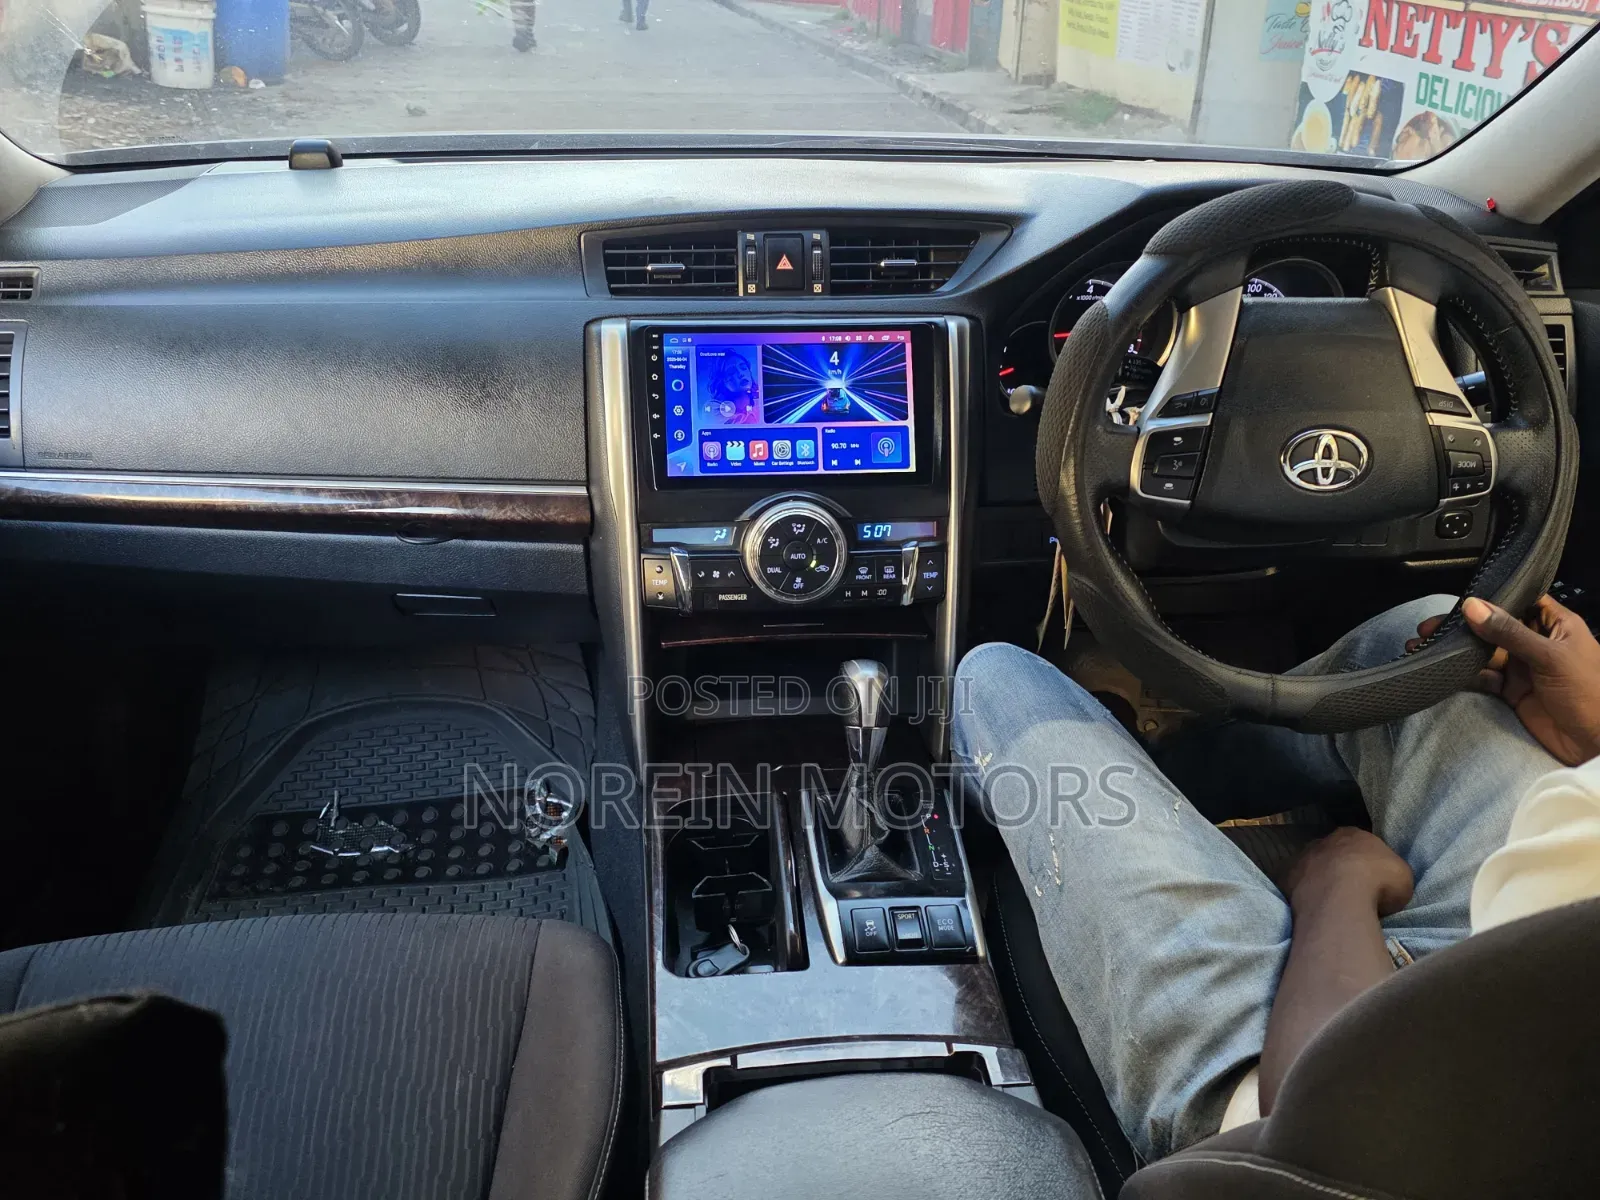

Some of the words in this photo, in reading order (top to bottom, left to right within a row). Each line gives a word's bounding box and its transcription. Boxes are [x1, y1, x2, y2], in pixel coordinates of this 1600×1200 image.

[1358, 0, 1571, 90] NETTY'S
[1087, 285, 1094, 294] 4
[1247, 283, 1262, 293] 100
[829, 350, 840, 366] 4
[1457, 460, 1477, 469] MODE
[816, 537, 828, 545] A/C
[718, 593, 748, 601] PASSENGER
[897, 912, 915, 920] SPORT
[937, 918, 954, 926] ECO
